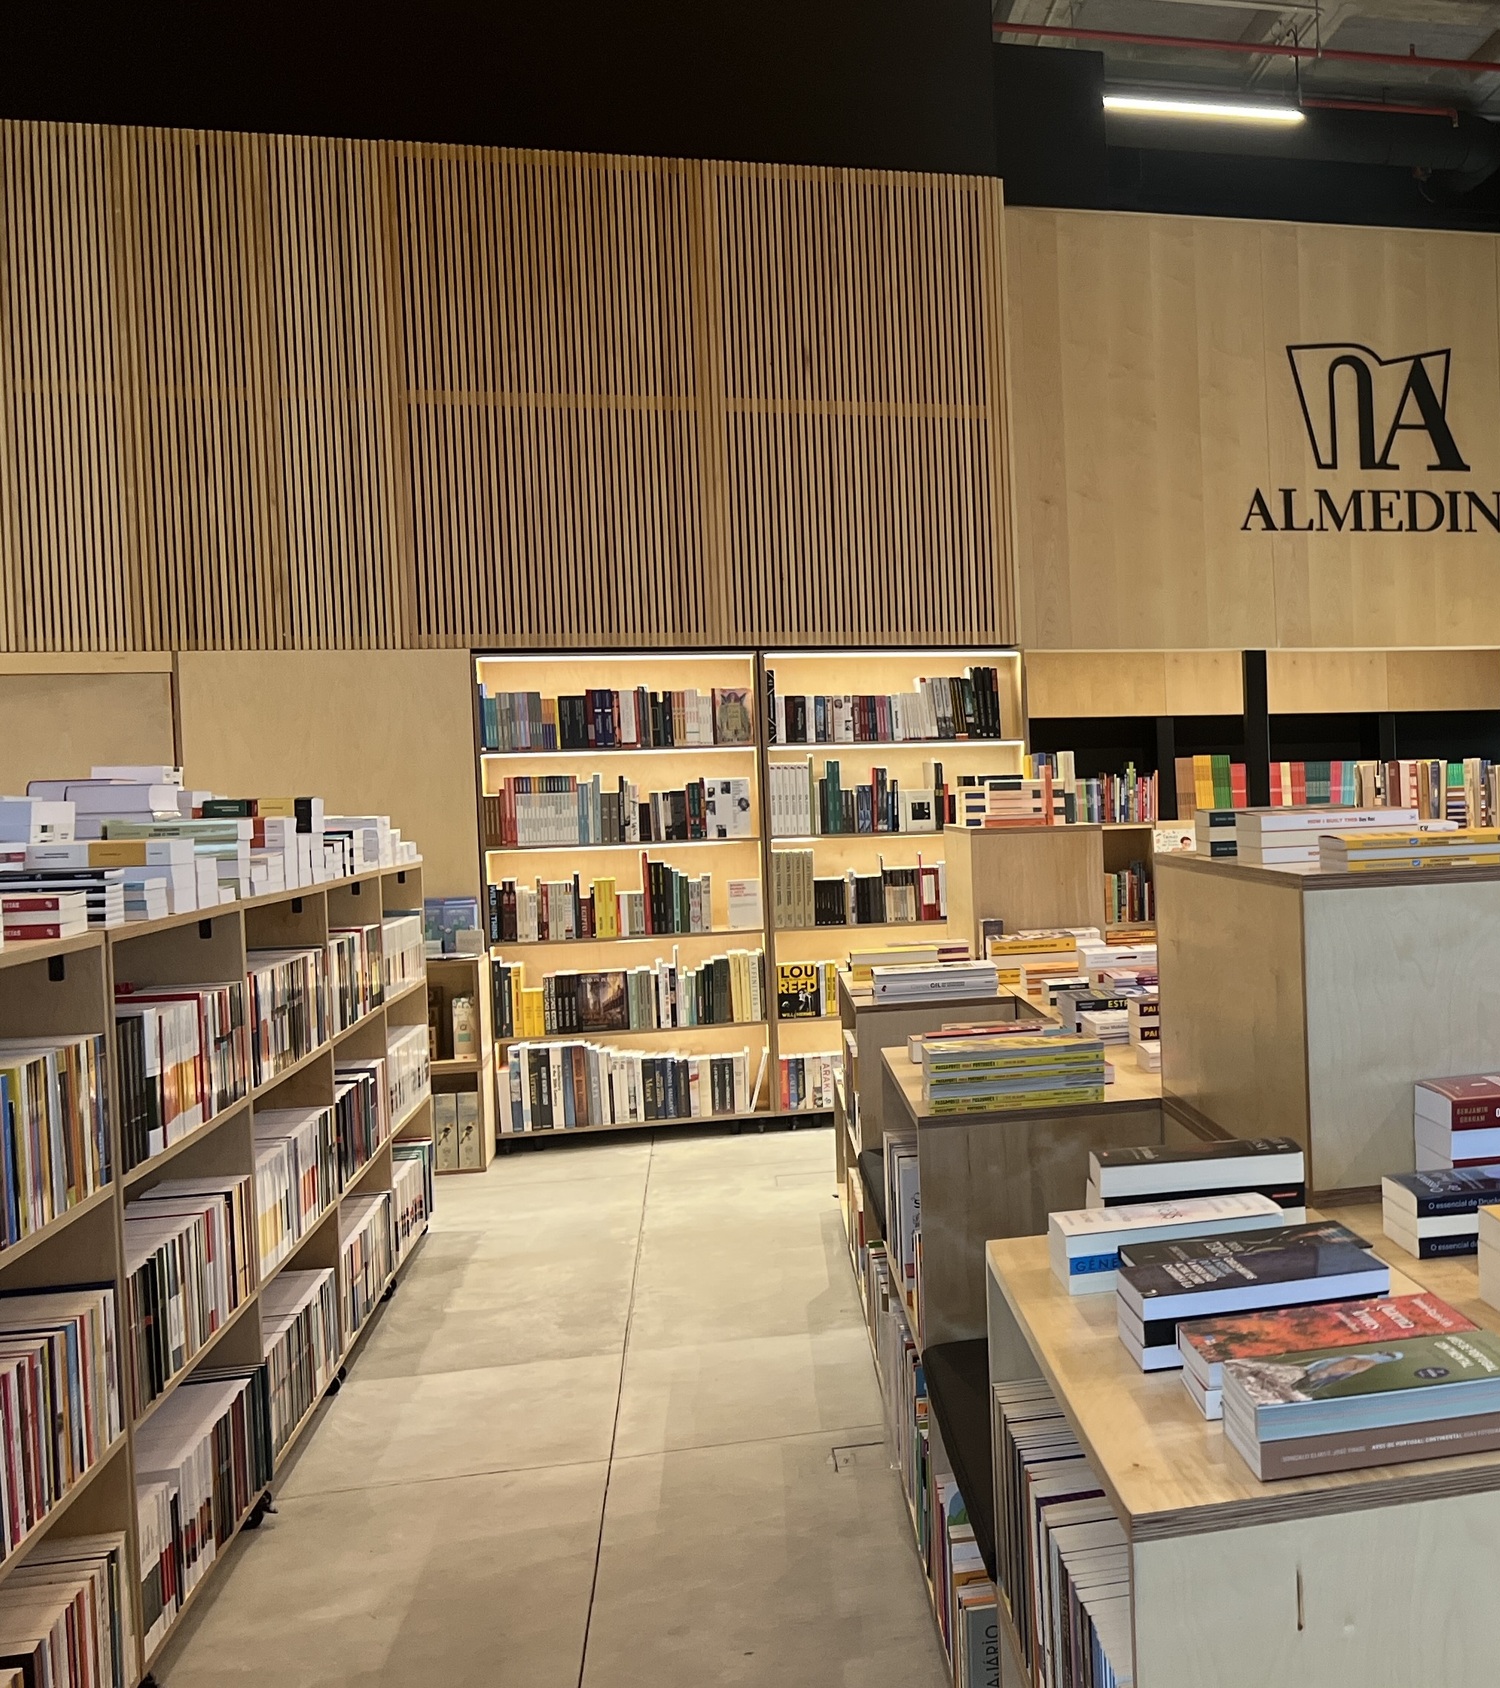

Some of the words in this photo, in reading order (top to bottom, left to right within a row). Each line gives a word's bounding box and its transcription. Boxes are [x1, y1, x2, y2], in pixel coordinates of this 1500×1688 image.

[781, 966, 815, 978] LOU
[750, 961, 759, 1007] AFFINITIES
[779, 980, 817, 994] REED
[1144, 1030, 1158, 1038] PAI
[822, 1063, 831, 1093] ARAKI
[530, 1073, 539, 1105] Vermeer
[644, 1077, 654, 1102] Monet
[1496, 1108, 1500, 1118] O
[1428, 1202, 1434, 1210] O
[1436, 1200, 1467, 1209] essencial
[1468, 1199, 1477, 1207] de
[1438, 1241, 1469, 1251] essencial
[1075, 1256, 1120, 1273] GÉNE
